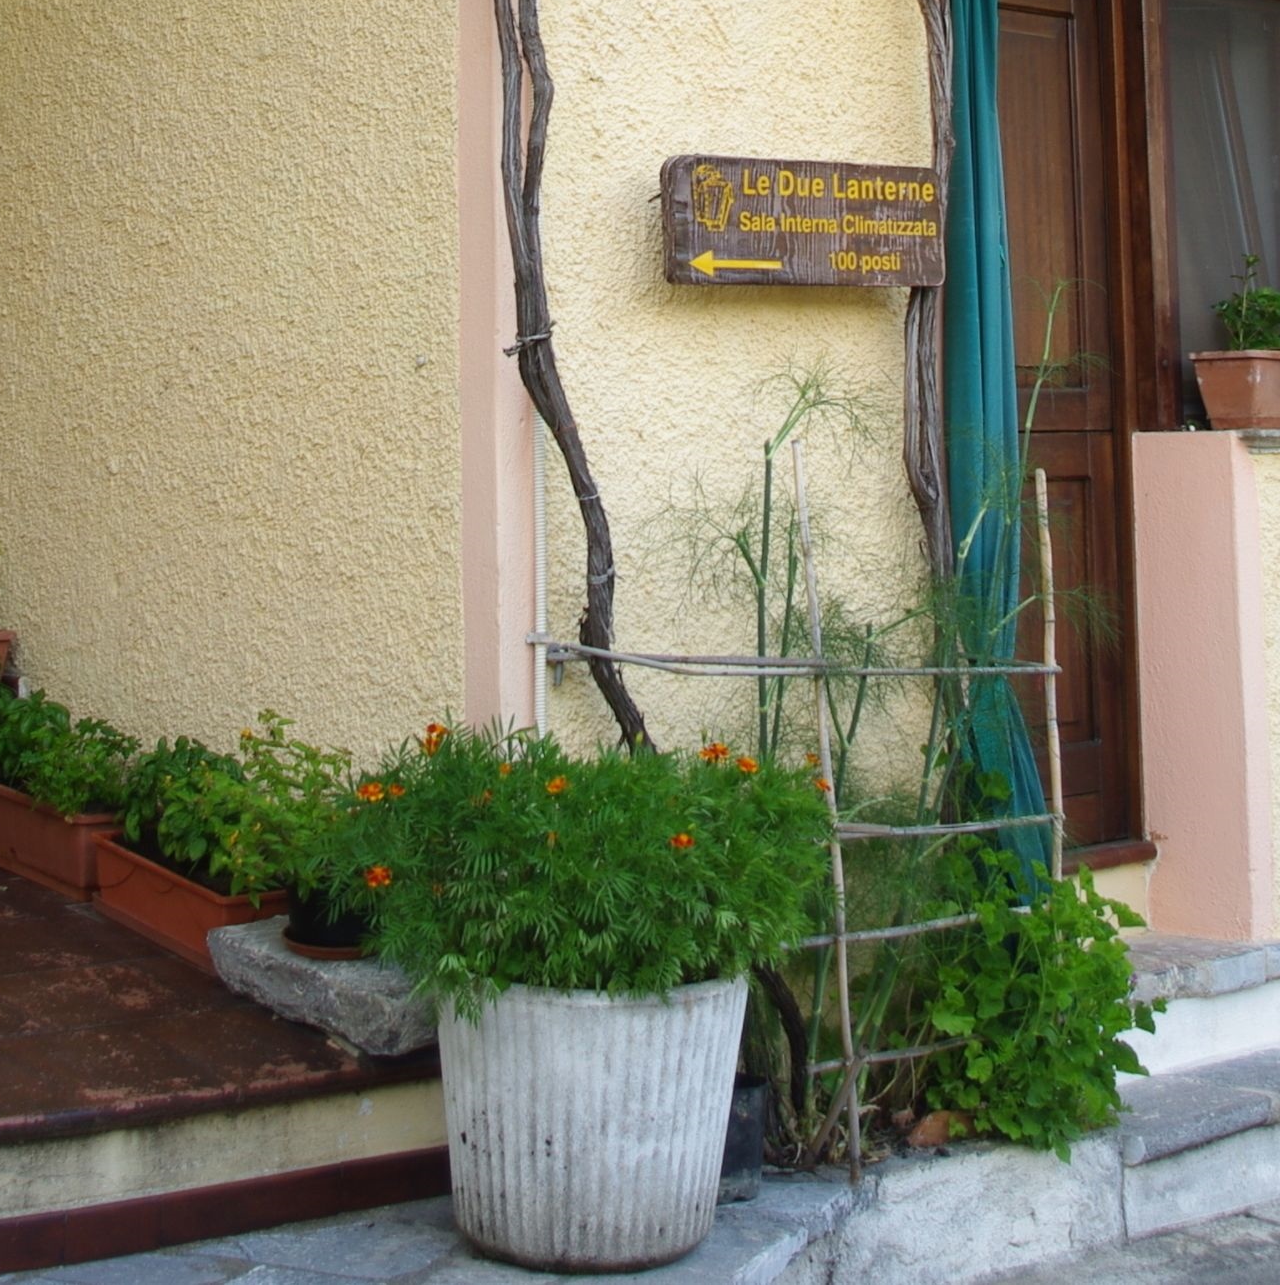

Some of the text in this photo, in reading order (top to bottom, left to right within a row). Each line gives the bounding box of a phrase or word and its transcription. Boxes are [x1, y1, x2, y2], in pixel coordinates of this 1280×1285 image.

[743, 169, 935, 202] Le Due Lanterne
[739, 211, 937, 236] Sala Interna Climatizzata
[829, 251, 902, 275] 100 posti
